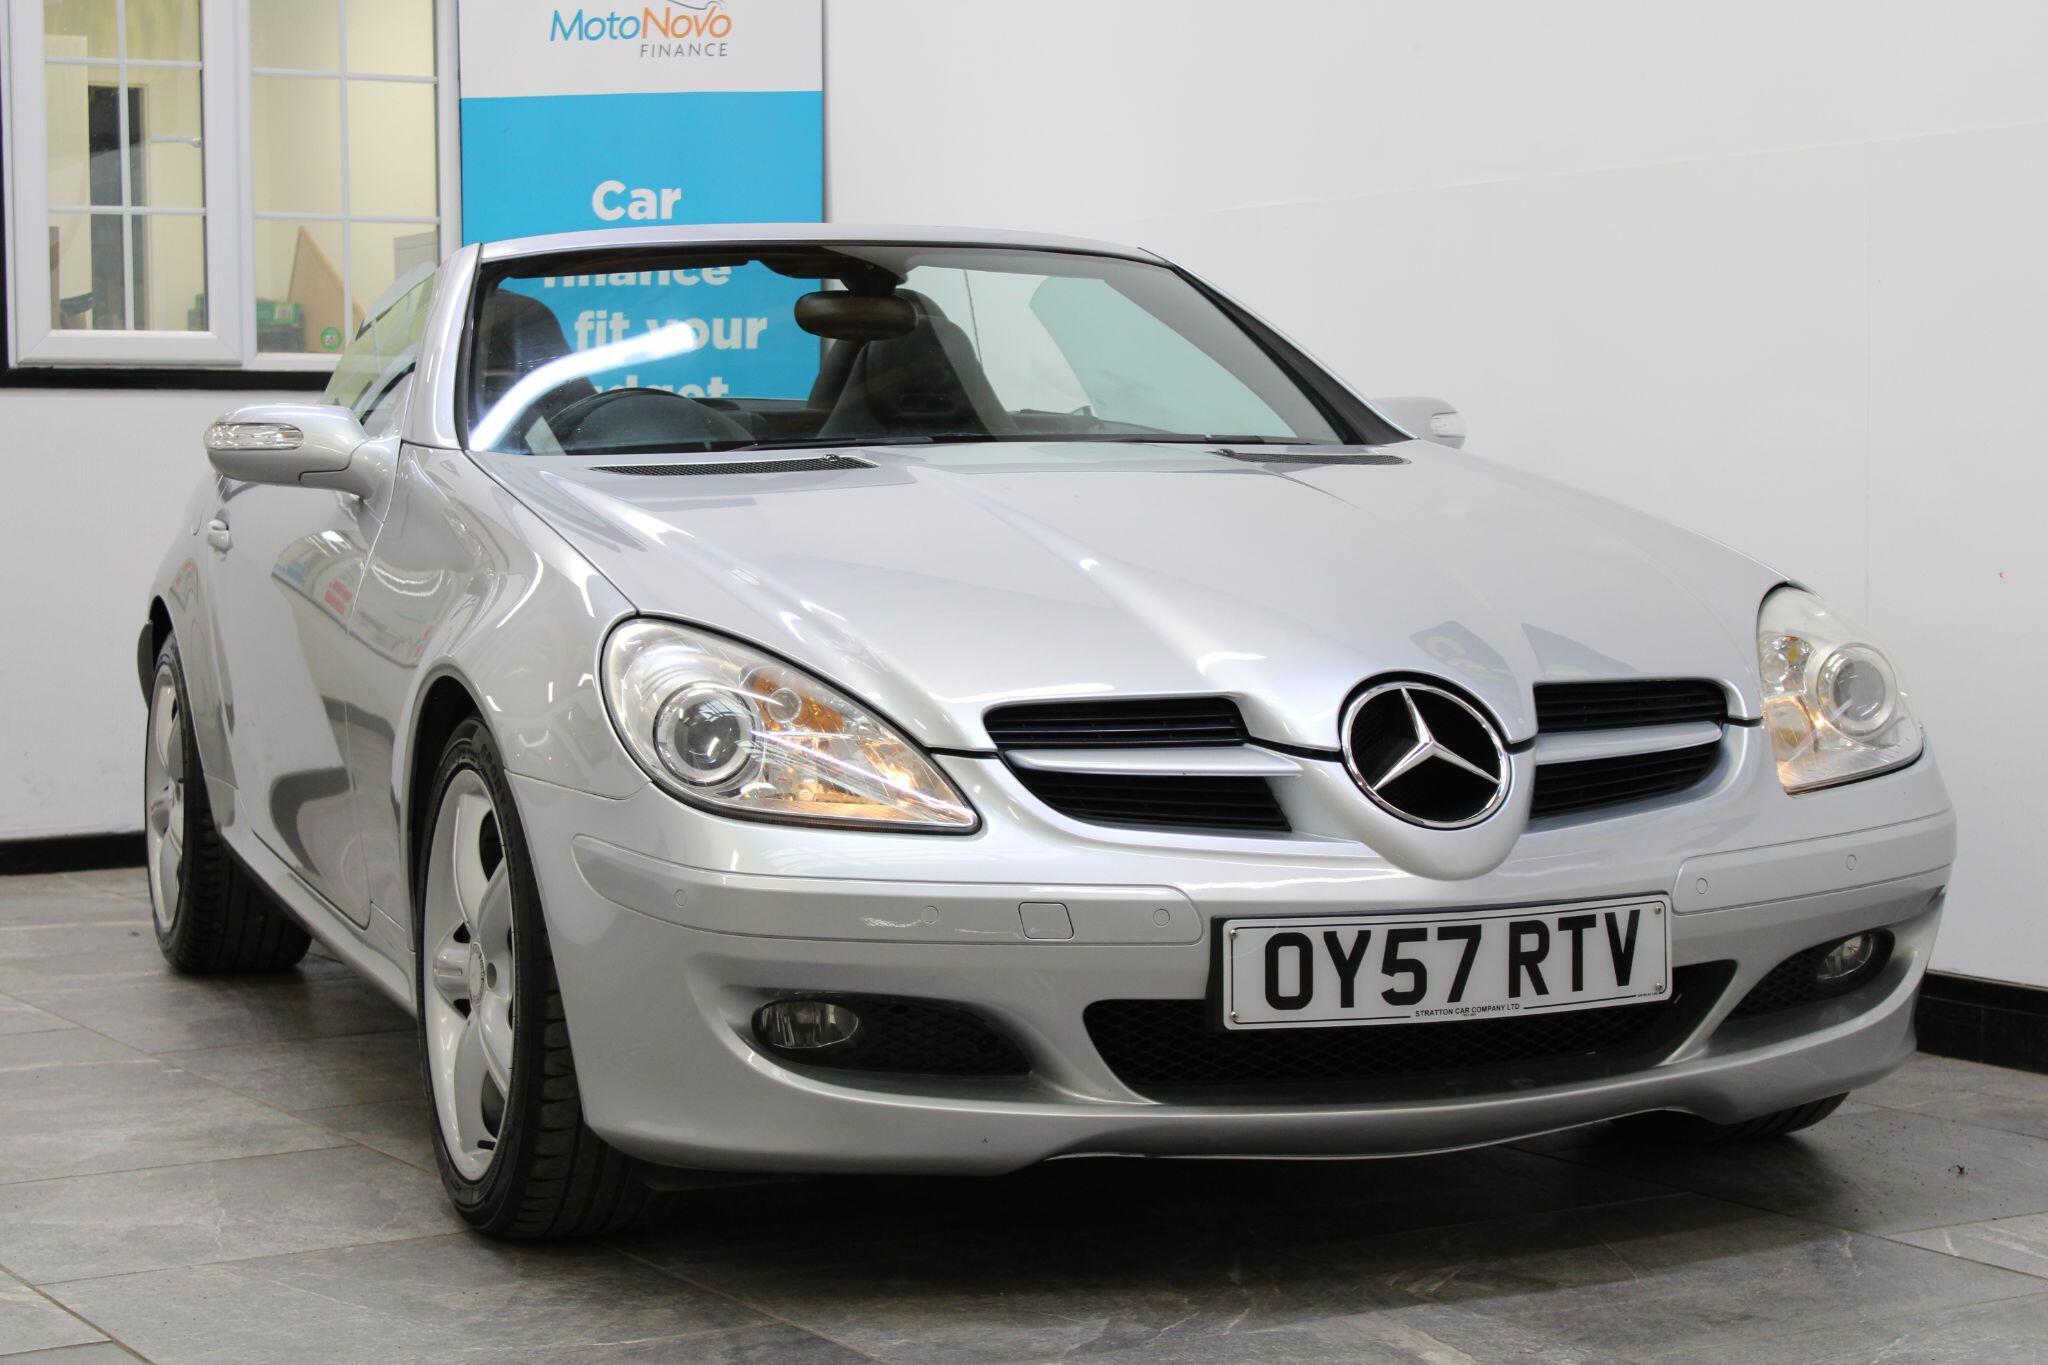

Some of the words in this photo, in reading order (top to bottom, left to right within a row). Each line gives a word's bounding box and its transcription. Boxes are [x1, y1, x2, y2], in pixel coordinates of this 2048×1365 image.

[550, 6, 732, 42] MotoNovo
[640, 43, 728, 58] FINANCE
[592, 180, 682, 221] Car
[574, 310, 630, 352] fit
[645, 318, 768, 351] our
[1264, 924, 1482, 1010] OY57
[1508, 909, 1641, 998] RTV
[1415, 1008, 1454, 1017] STRATTON
[1455, 1007, 1470, 1015] CAR
[1471, 1004, 1506, 1013] COMPANY
[1506, 1003, 1521, 1011] LTD
